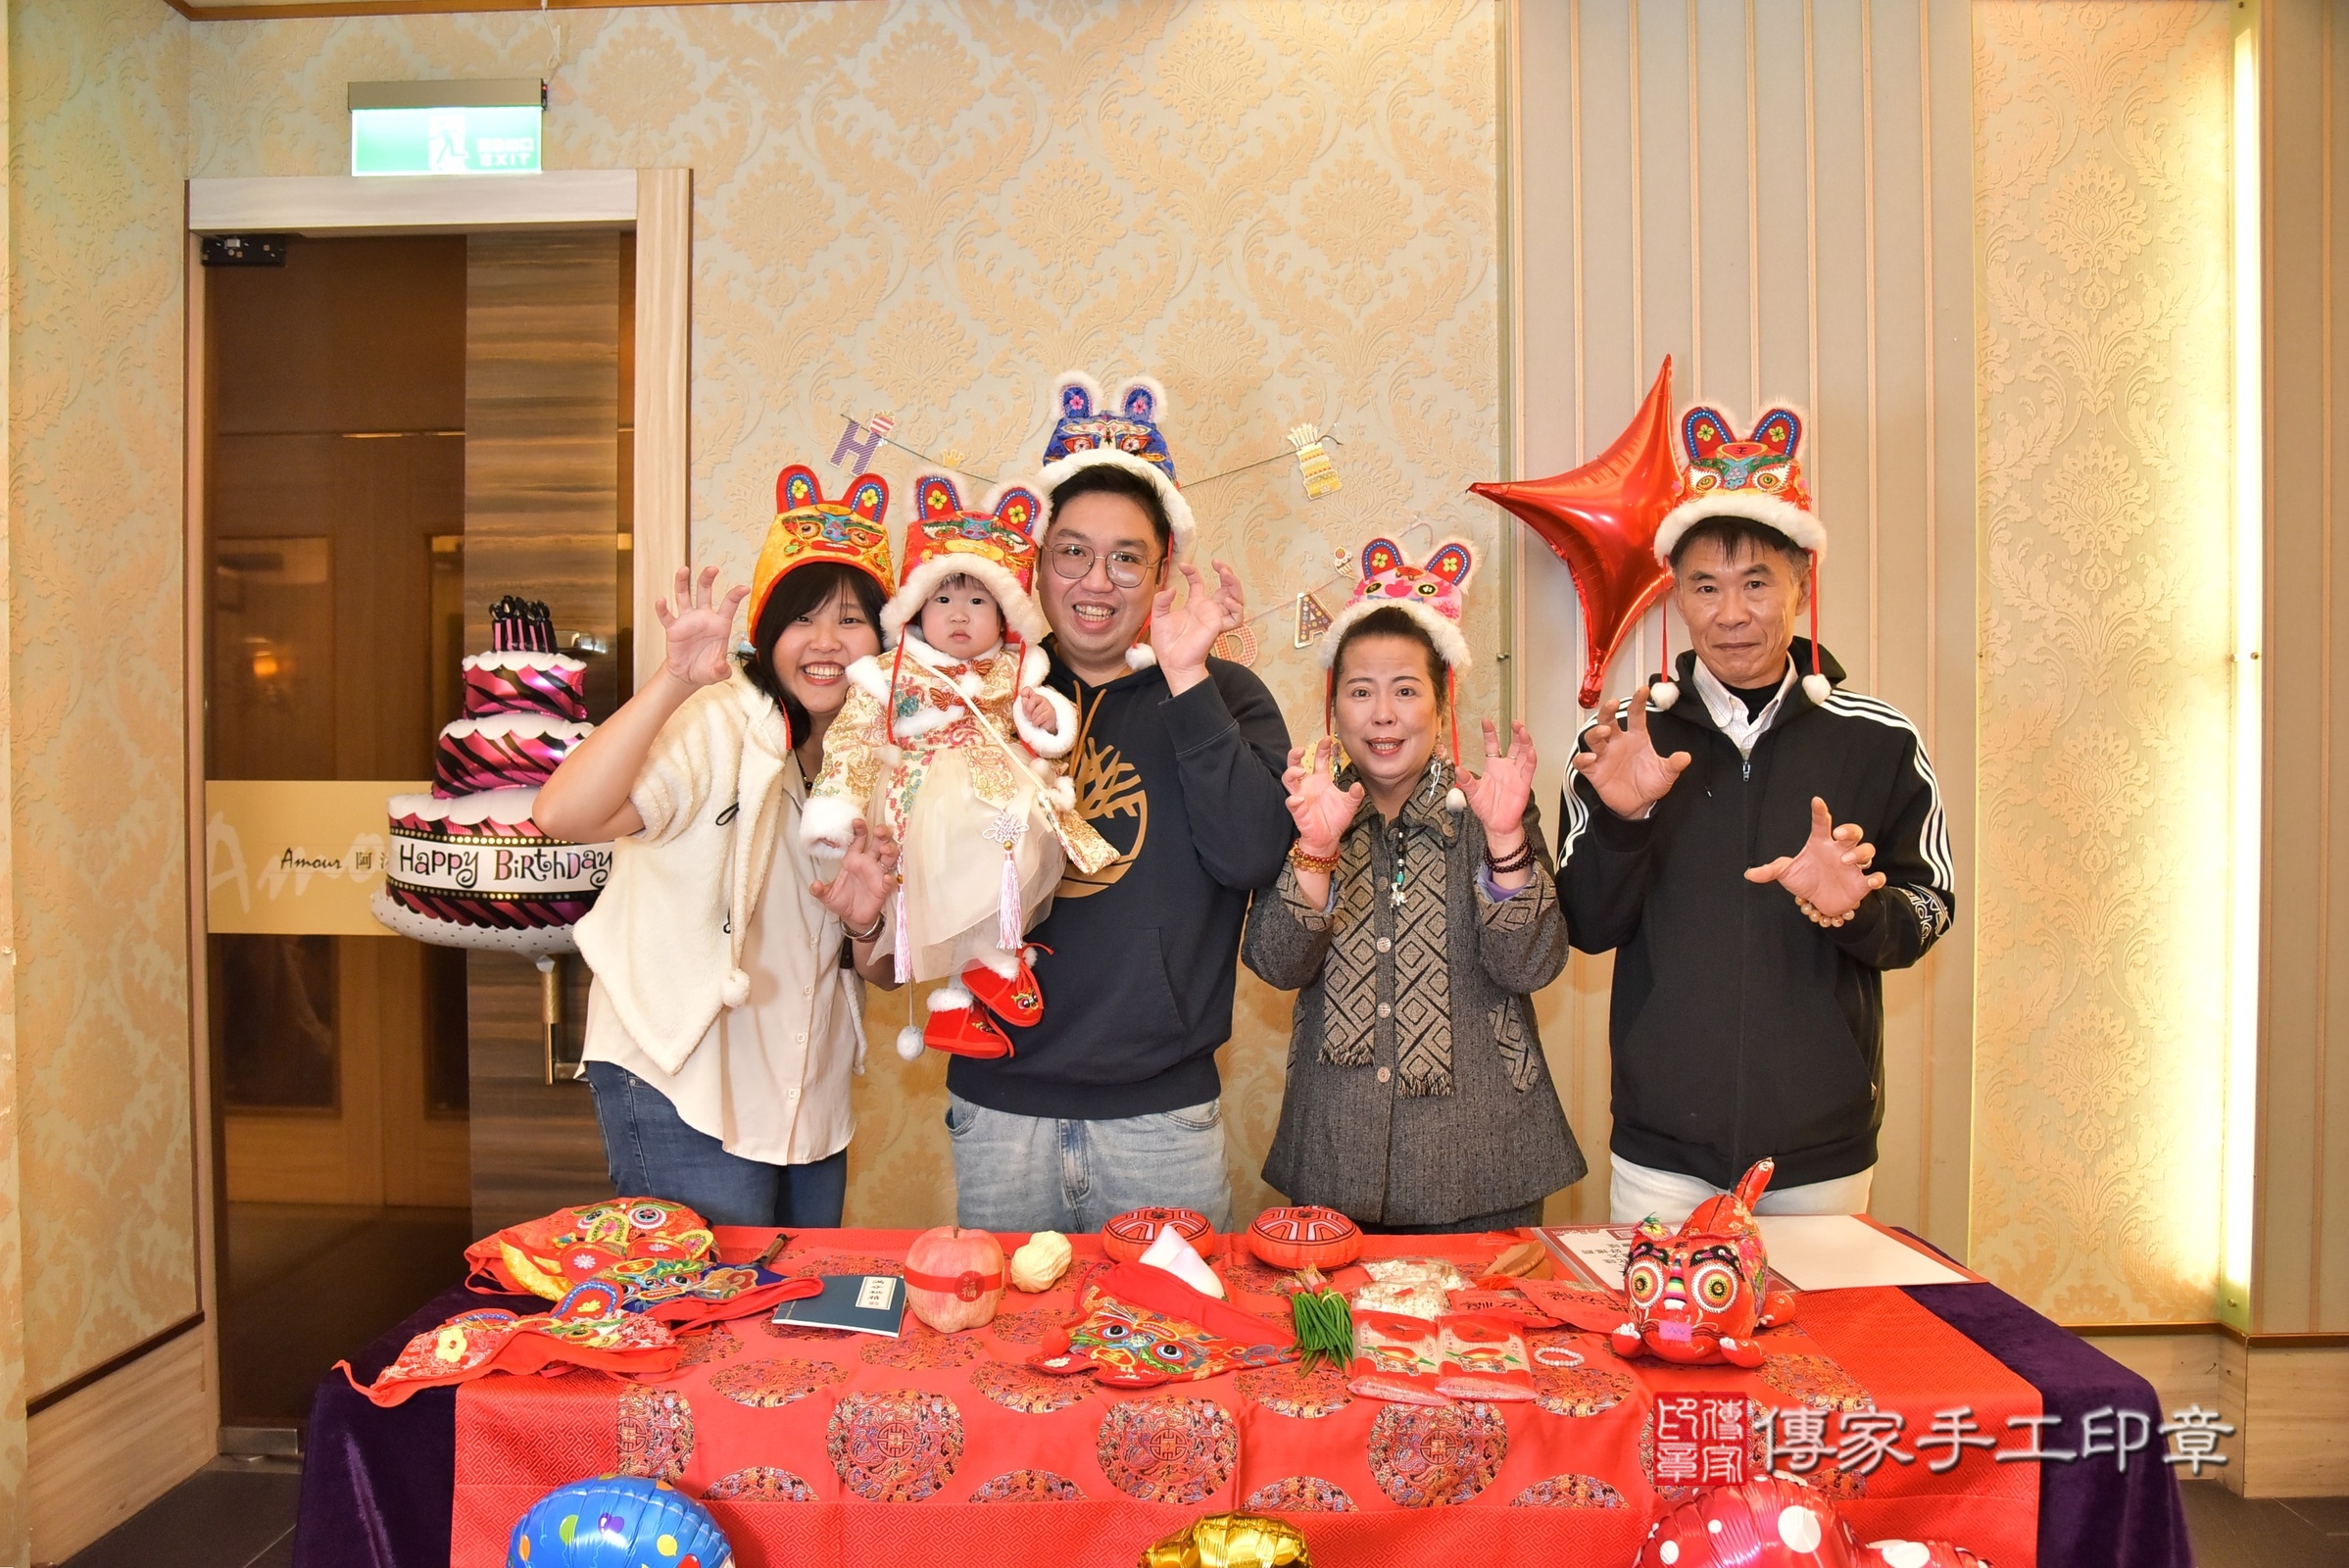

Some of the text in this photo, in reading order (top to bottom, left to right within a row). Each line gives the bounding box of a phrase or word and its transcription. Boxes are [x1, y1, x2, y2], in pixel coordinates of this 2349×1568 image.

[479, 152, 532, 167] EXIT
[280, 847, 342, 870] Amour
[400, 843, 478, 889] Happy
